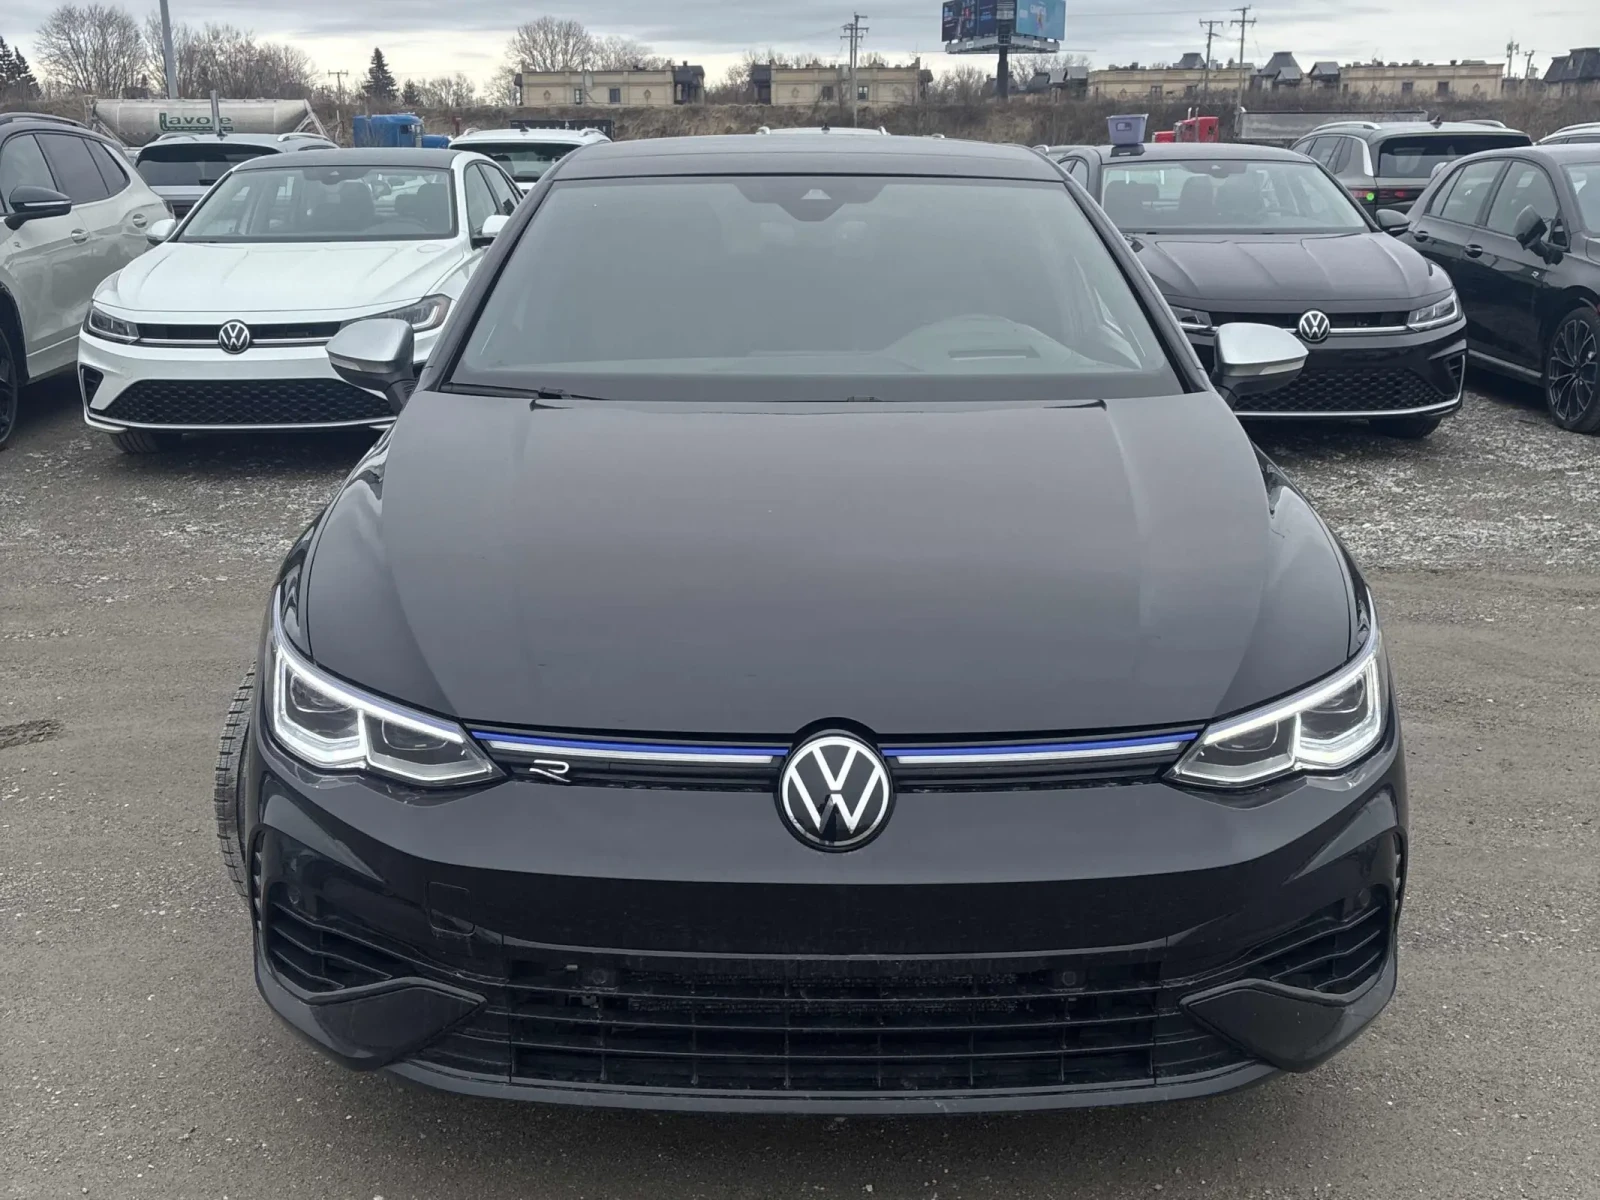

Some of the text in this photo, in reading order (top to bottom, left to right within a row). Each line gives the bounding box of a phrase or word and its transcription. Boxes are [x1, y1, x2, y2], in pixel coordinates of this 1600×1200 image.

[159, 112, 234, 132] Lavoe
[219, 321, 250, 353] VW
[1300, 311, 1330, 341] VW
[529, 758, 571, 783] R
[782, 736, 889, 844] VW
